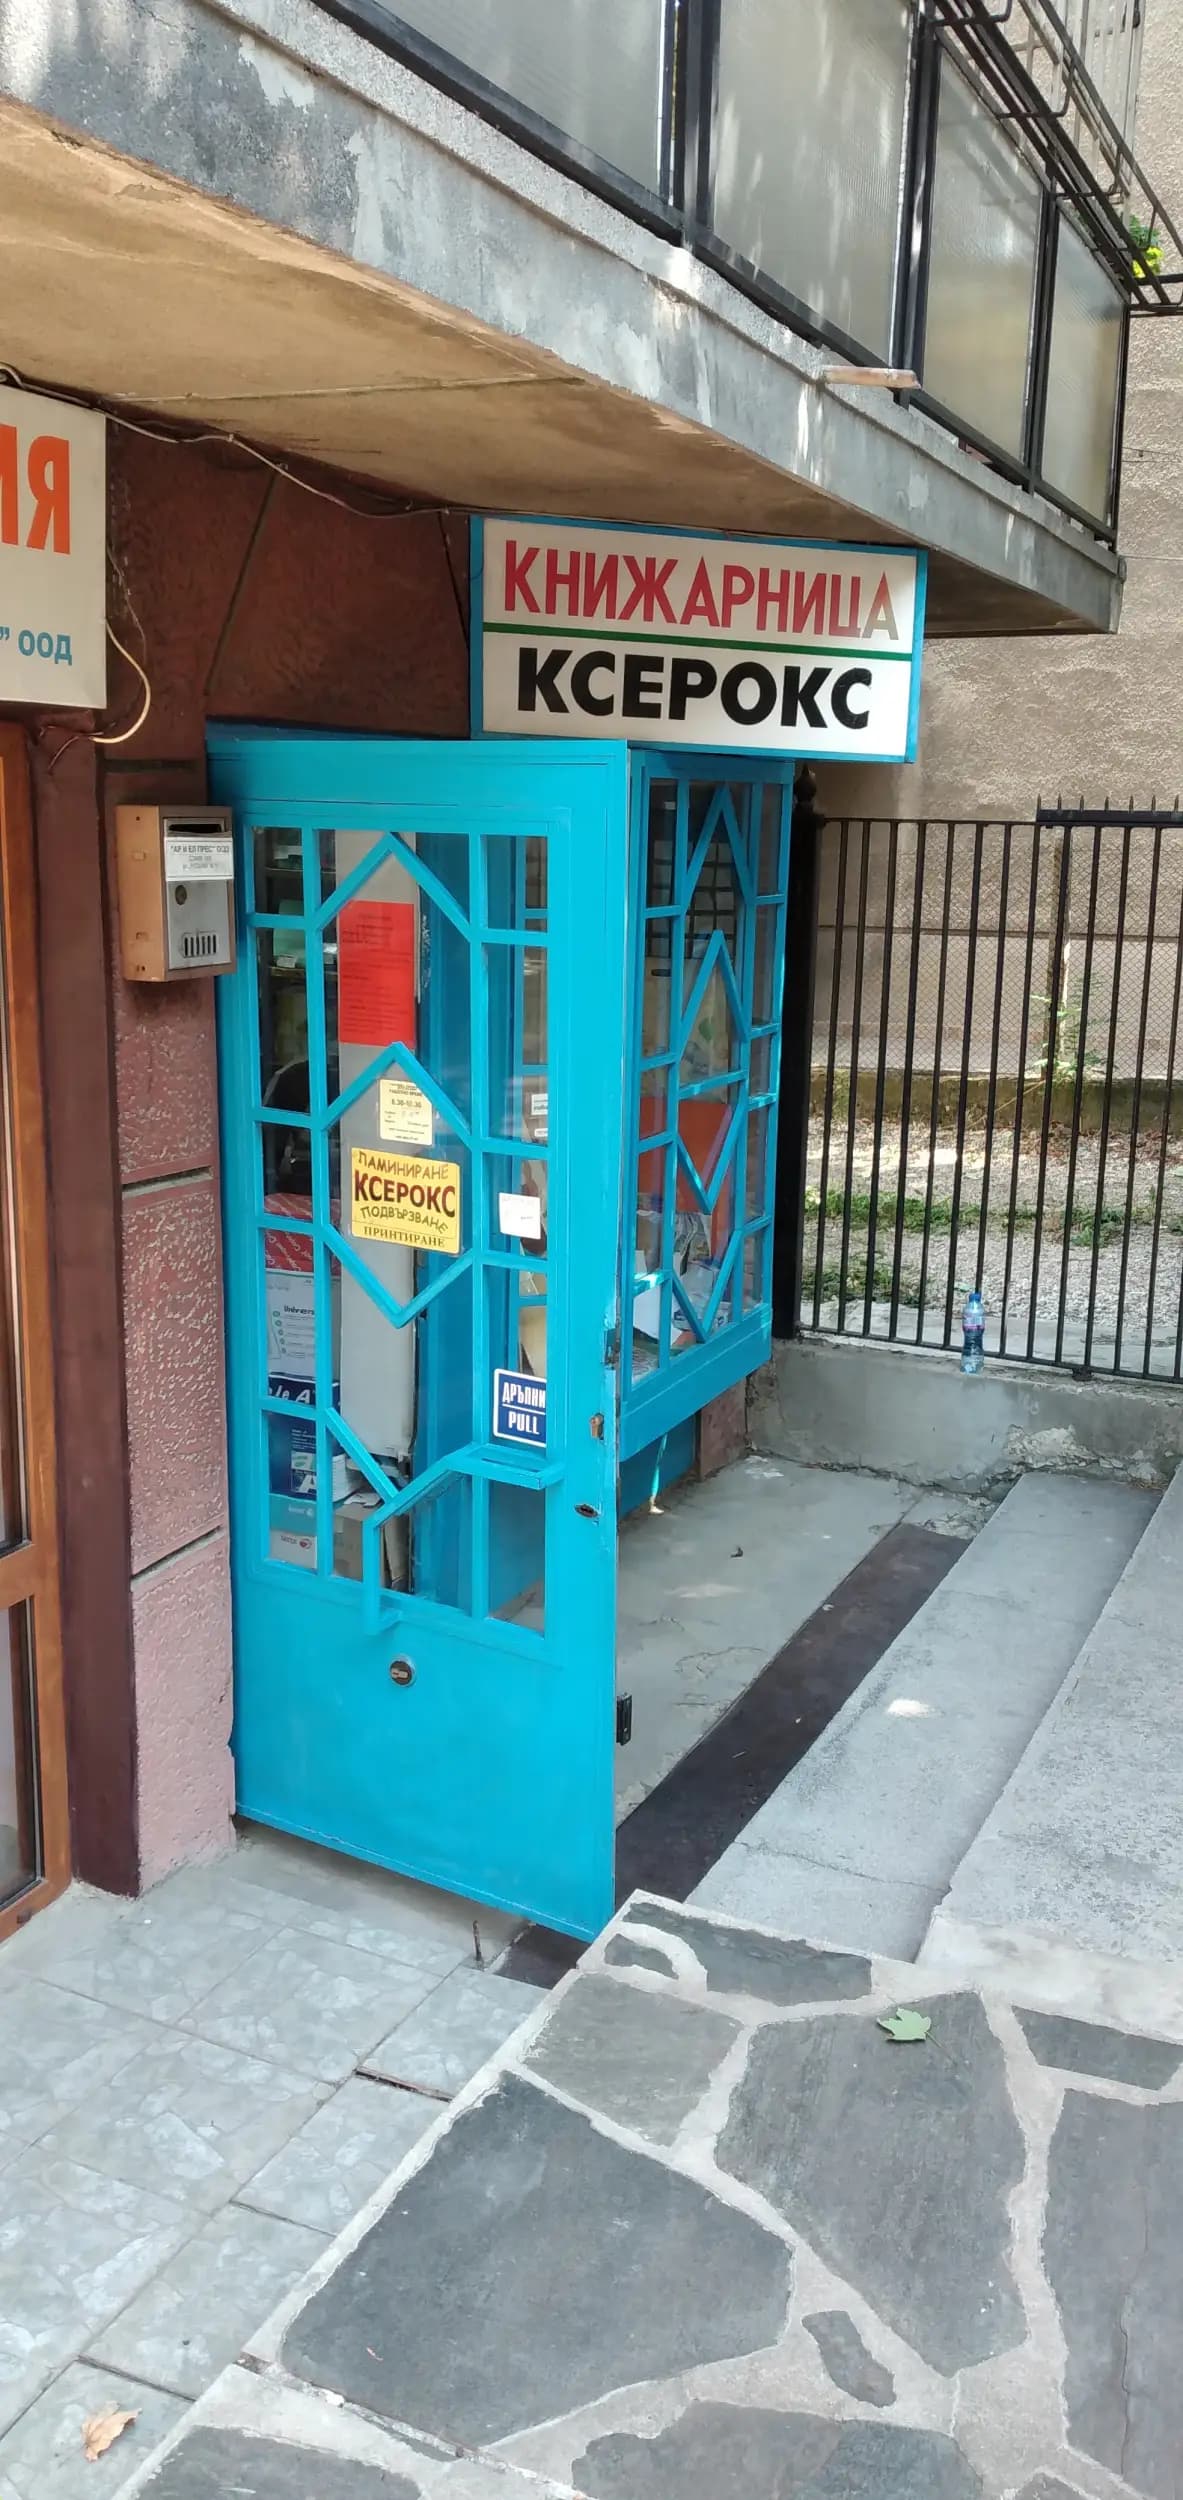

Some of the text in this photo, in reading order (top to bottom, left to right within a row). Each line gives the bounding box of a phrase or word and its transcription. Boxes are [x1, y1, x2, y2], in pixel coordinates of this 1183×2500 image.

[504, 540, 899, 641] КНИЖАРНИЦА
[18, 629, 72, 666] ООД
[517, 647, 873, 730] КСЕРОКС
[358, 1151, 449, 1180] ЛАМИНИРАНЕ
[353, 1168, 456, 1218] КСЕРОКС
[360, 1205, 449, 1235] ПОДВЪРЗВАНЕ
[363, 1225, 446, 1248] ПРИНТИРАНЕ
[502, 1382, 546, 1409] ДРЪПНИ
[508, 1410, 540, 1435] PULL
